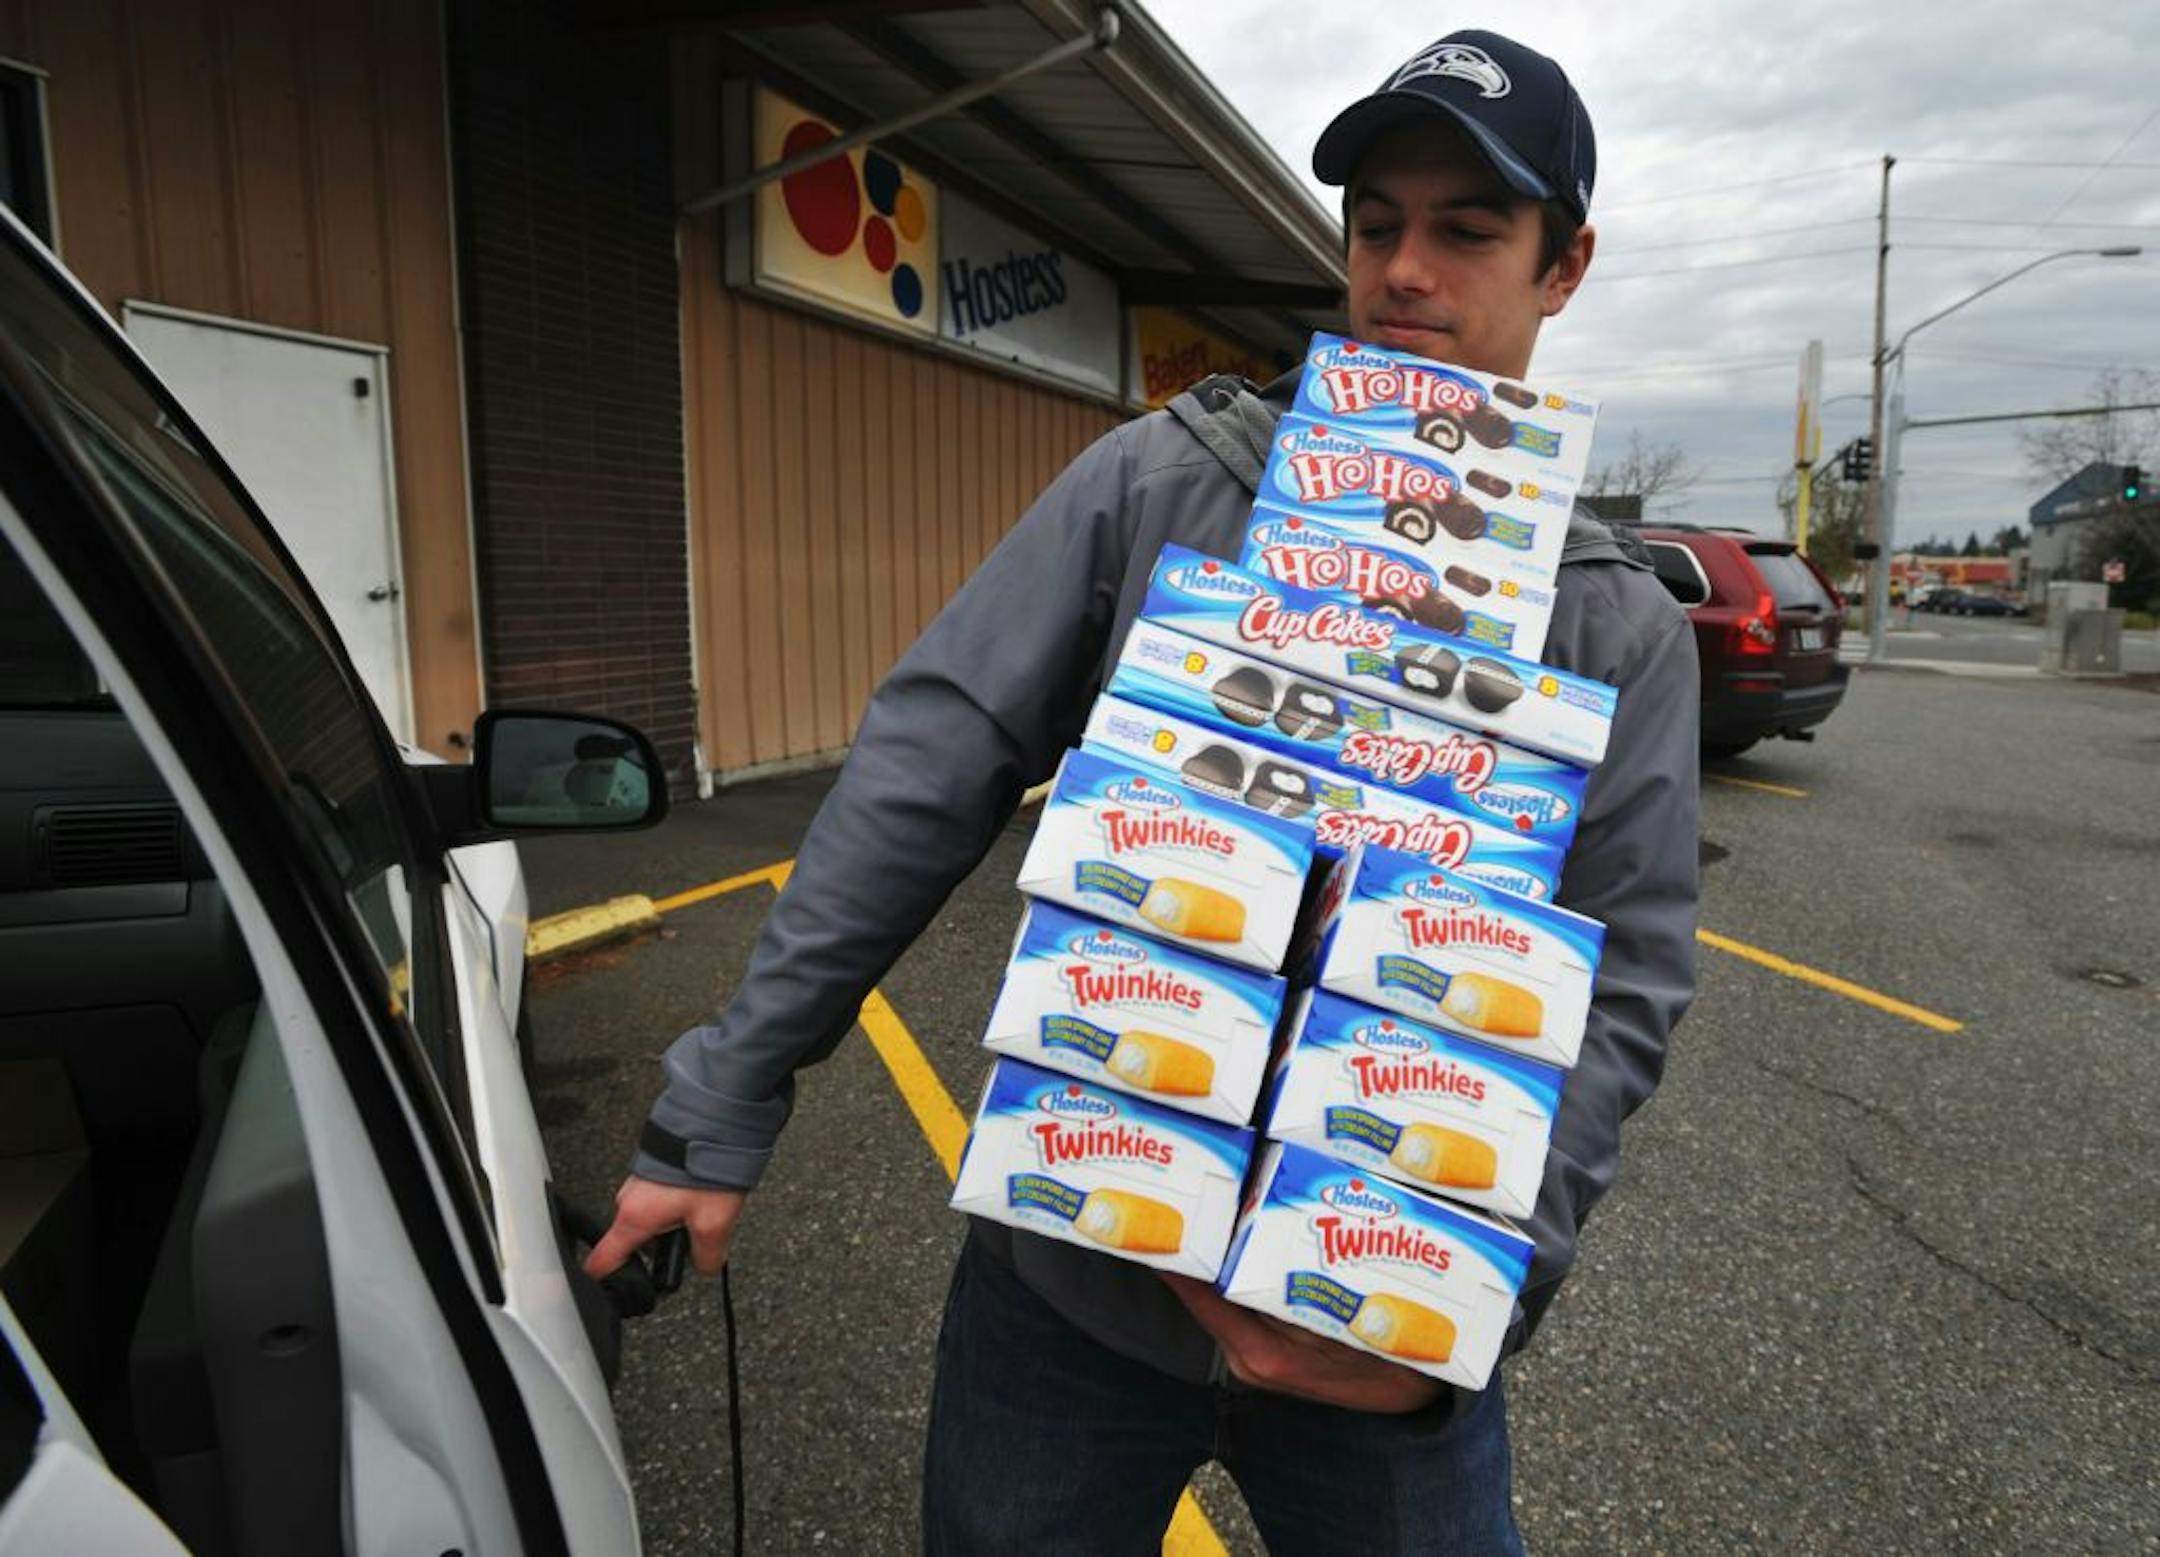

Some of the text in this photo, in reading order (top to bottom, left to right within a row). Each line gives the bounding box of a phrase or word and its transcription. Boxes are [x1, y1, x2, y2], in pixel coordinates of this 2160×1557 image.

[943, 248, 1066, 337] Hostess
[1326, 348, 1391, 371] Hostess
[1293, 432, 1362, 456] Hostess
[1265, 523, 1338, 551] Hostess
[1178, 566, 1257, 597] Hostess
[1184, 652, 1206, 674] 8
[1538, 675, 1559, 698] 8
[1117, 783, 1175, 806] Hostess
[1480, 789, 1557, 824] Hostess
[1101, 810, 1237, 856] Twinkies
[1414, 879, 1471, 904] Hostess
[1401, 909, 1532, 954] Twinkies
[1081, 935, 1140, 959] Hostess
[1066, 963, 1203, 1010] Twinkies
[1366, 1025, 1423, 1049] Hostess
[1351, 1054, 1486, 1100] Twinkies
[1051, 1092, 1111, 1115] Hostess
[1035, 1120, 1175, 1165] Twinkies
[1333, 1185, 1392, 1212] Hostess
[1315, 1217, 1451, 1271] Twinkies
